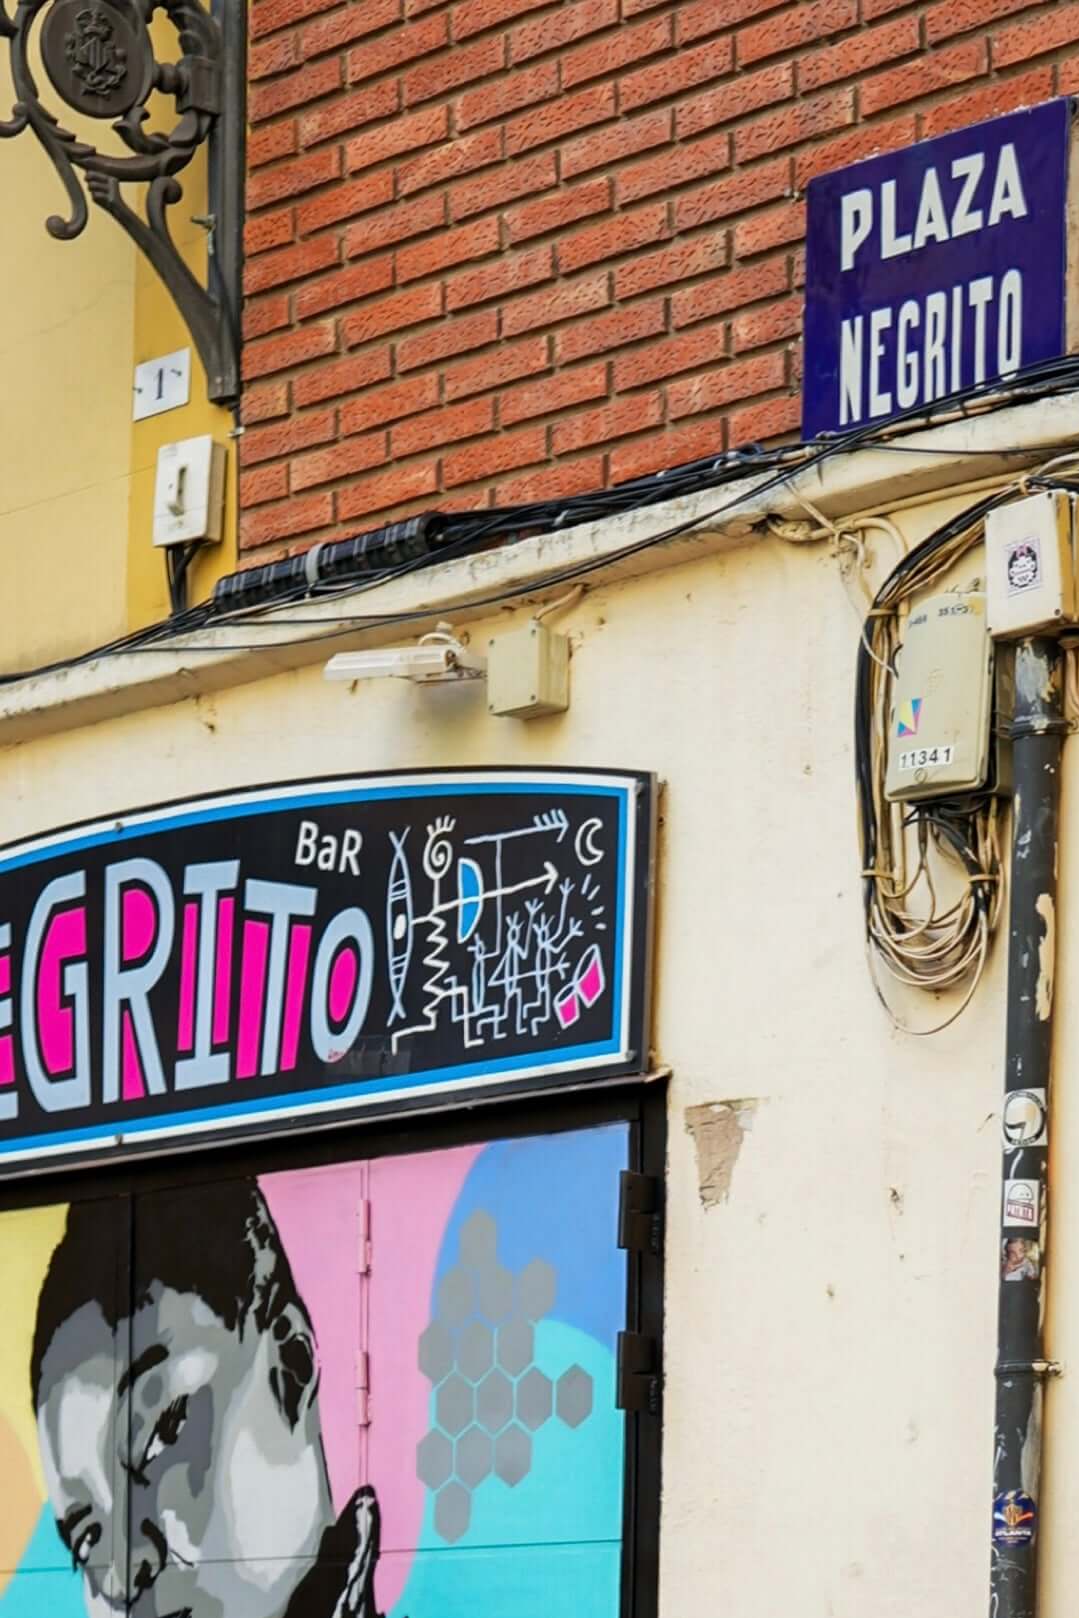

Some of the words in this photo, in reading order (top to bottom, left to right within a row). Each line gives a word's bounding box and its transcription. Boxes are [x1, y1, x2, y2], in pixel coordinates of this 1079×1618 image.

[840, 143, 1028, 272] PLAZA
[839, 268, 1023, 426] NEGRITO
[901, 748, 951, 768] 11341
[0, 857, 373, 1120] GRITO
